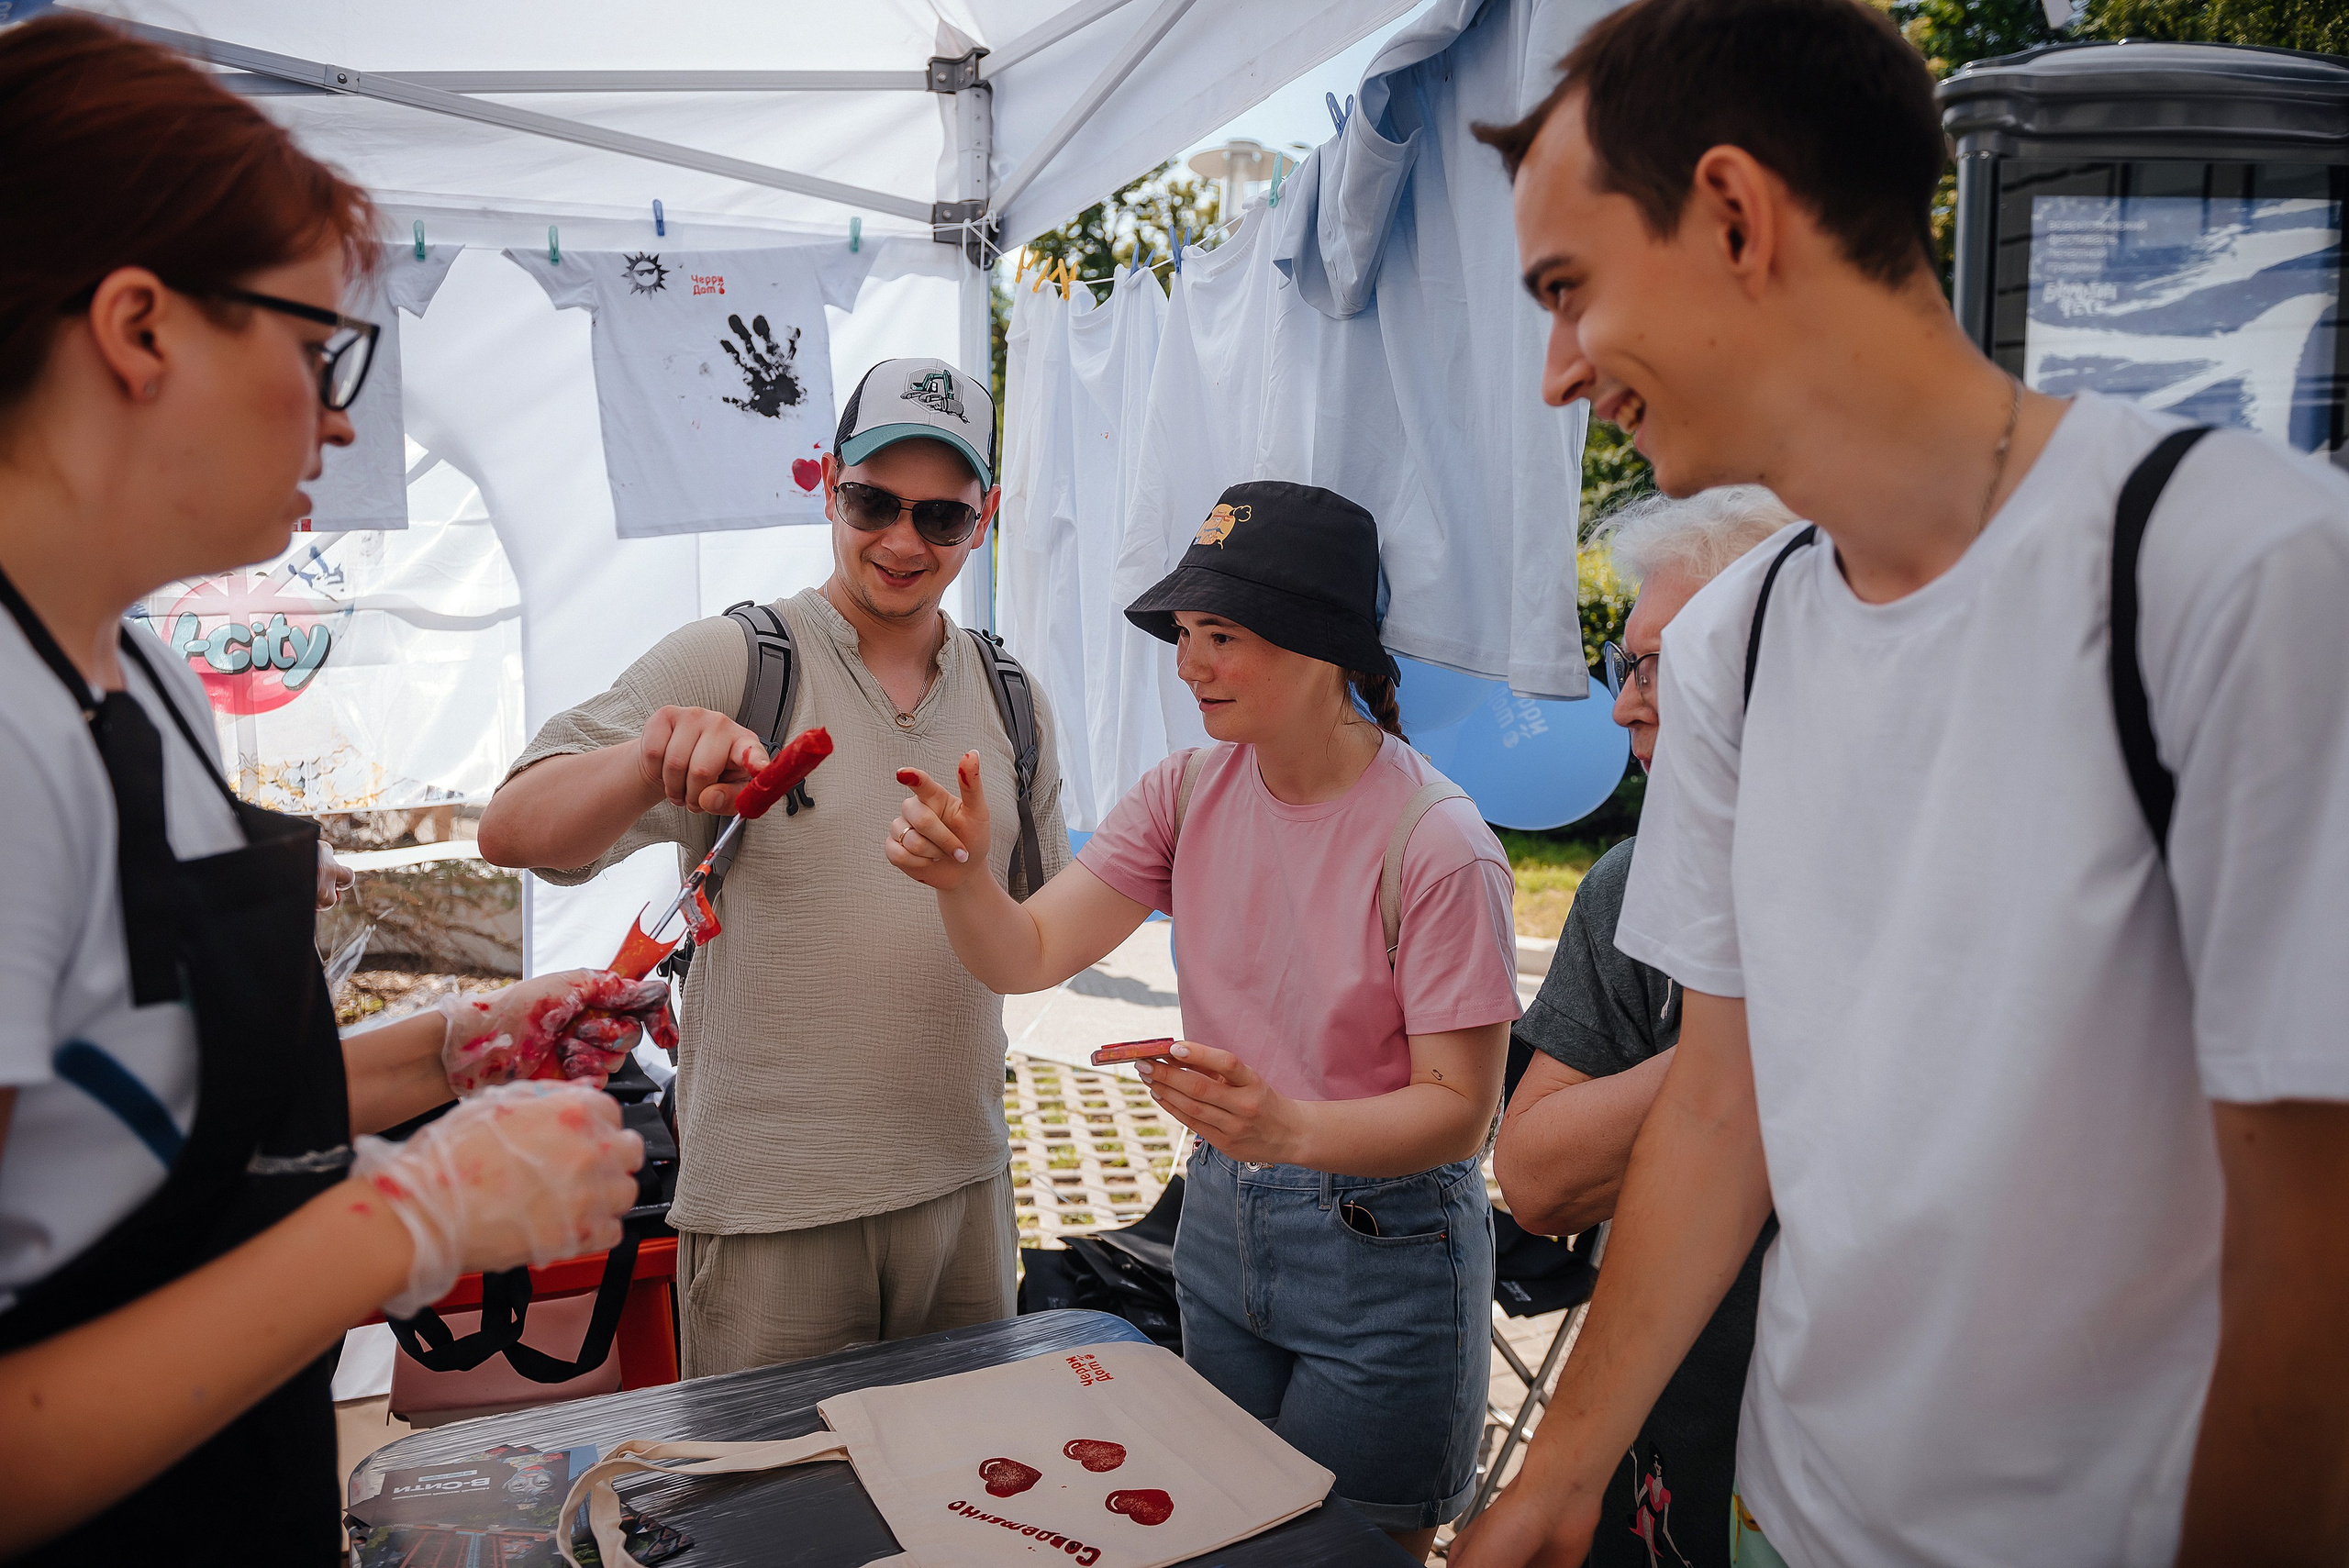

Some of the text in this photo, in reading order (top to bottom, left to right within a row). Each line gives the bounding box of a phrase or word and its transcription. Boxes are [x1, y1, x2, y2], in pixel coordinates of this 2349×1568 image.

[691, 274, 724, 285] Черри
[1510, 698, 1549, 735] рри
[1065, 1355, 1094, 1386] Черри
